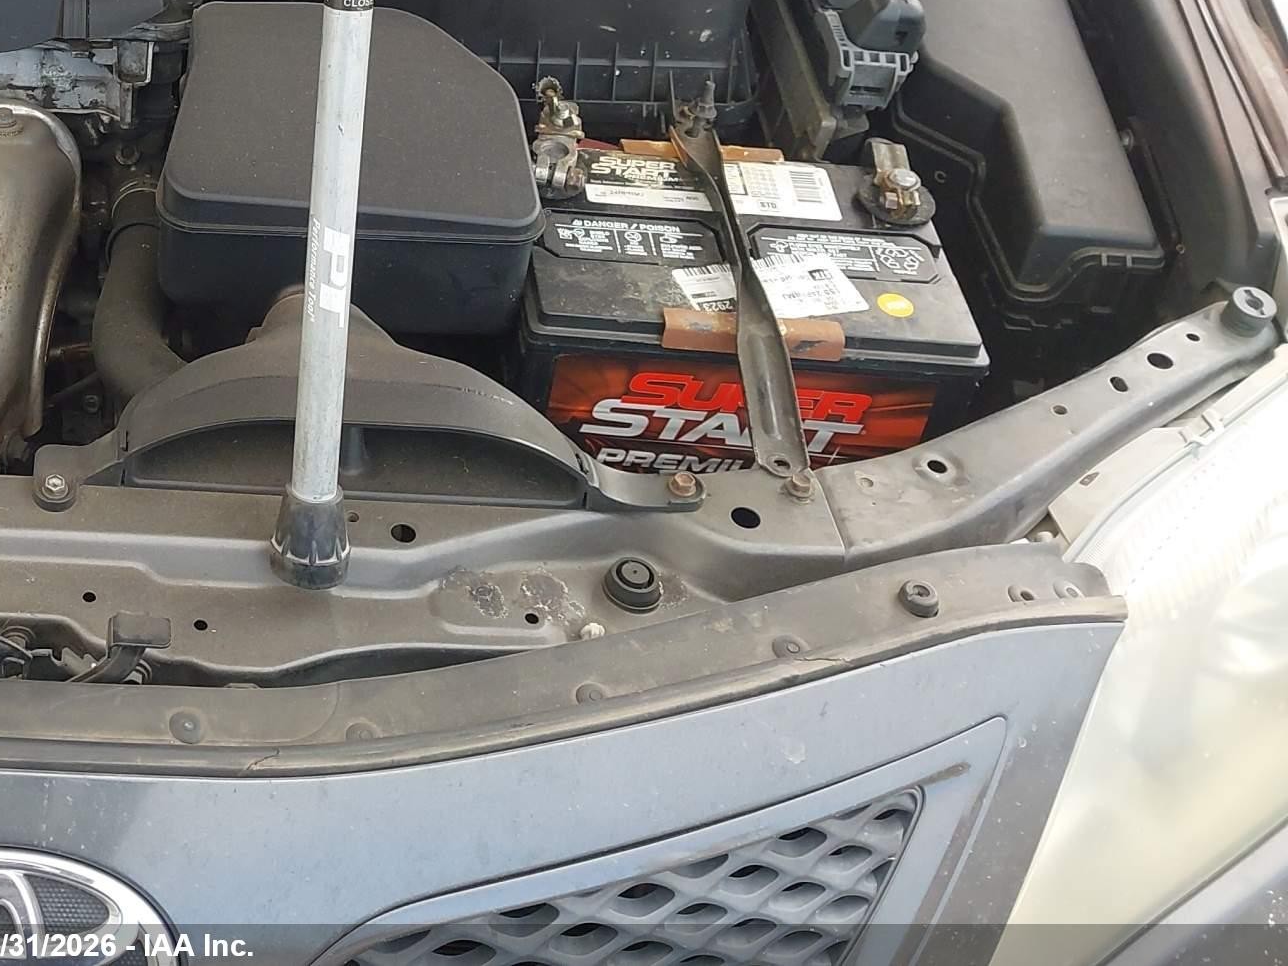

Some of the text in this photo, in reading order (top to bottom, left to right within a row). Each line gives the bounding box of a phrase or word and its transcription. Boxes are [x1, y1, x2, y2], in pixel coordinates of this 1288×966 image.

[590, 162, 678, 178] START
[598, 155, 677, 170] SUPER
[583, 220, 629, 230] DANGER
[639, 223, 681, 234] POISON
[620, 372, 872, 423] SUER
[578, 398, 865, 453] STAT
